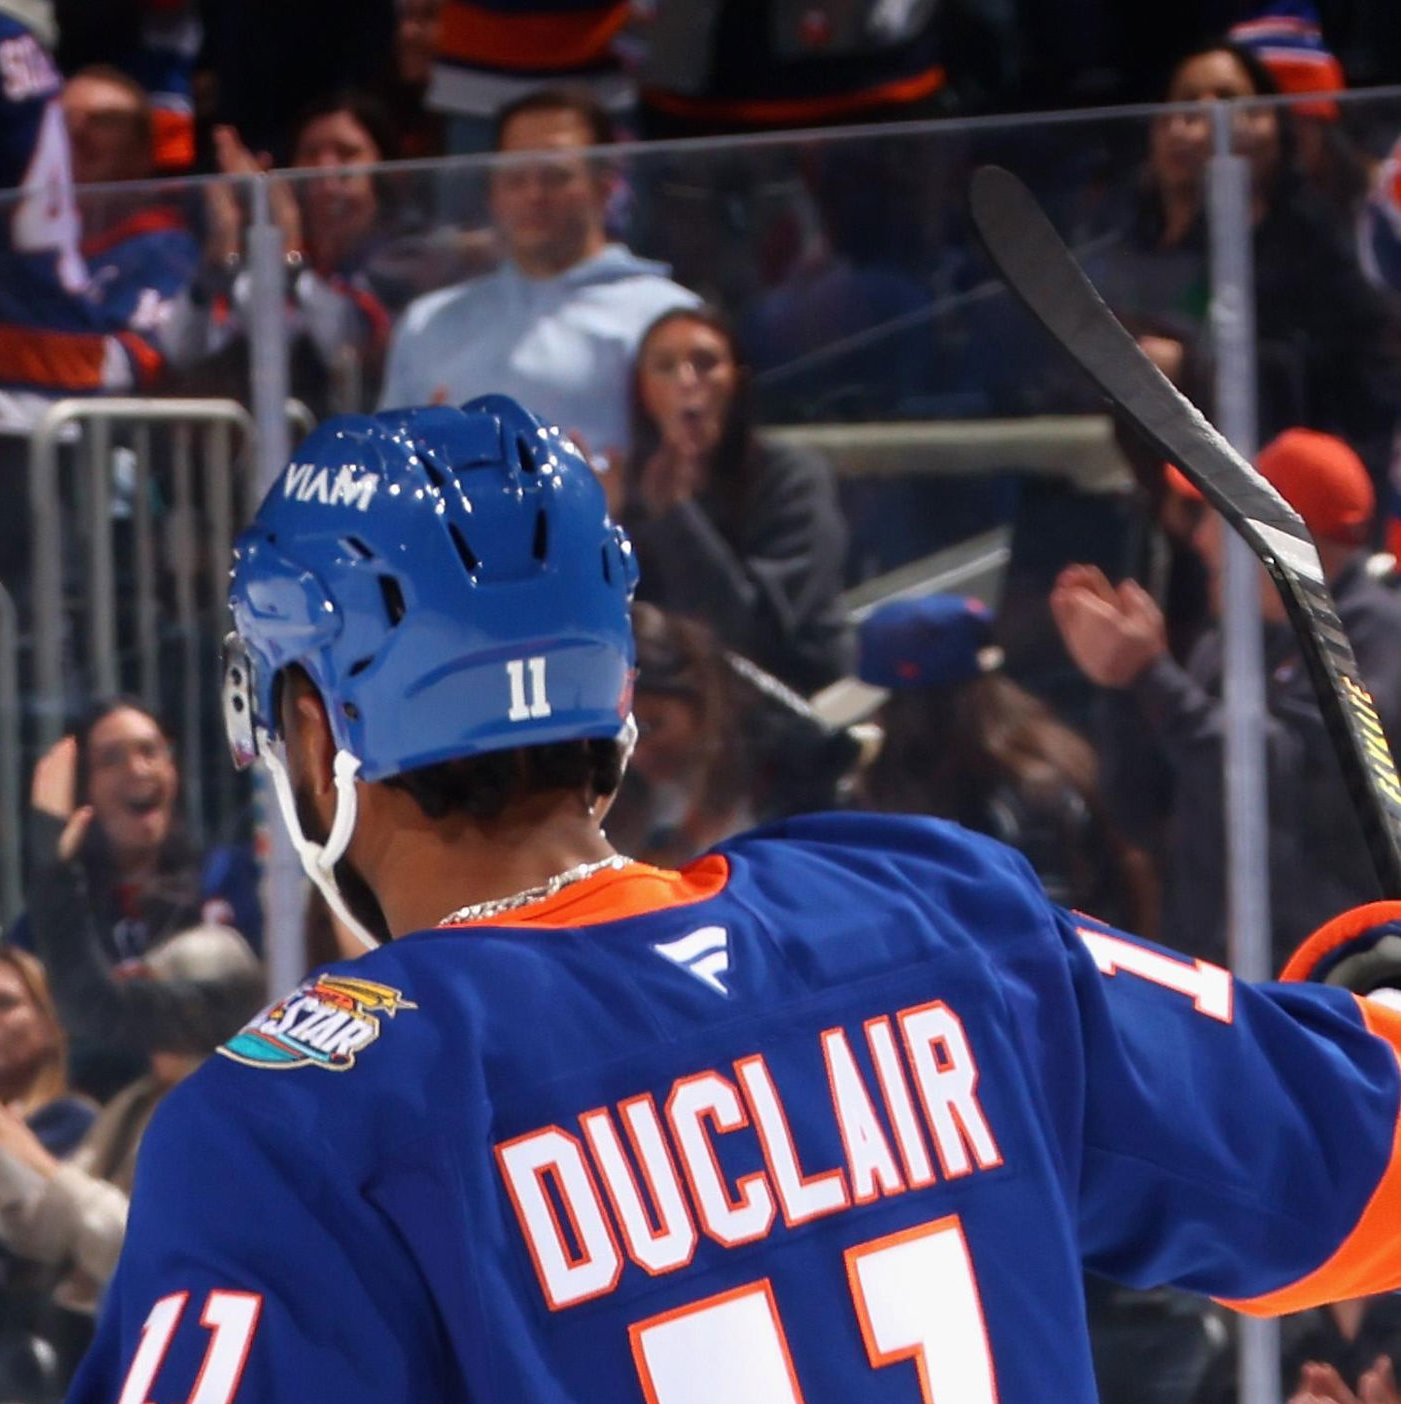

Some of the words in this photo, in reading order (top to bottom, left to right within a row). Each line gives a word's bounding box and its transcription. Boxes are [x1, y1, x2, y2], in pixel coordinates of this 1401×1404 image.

[284, 462, 380, 512] VIAM
[506, 656, 551, 722] 11
[494, 1000, 1004, 1312] DUCLAIR
